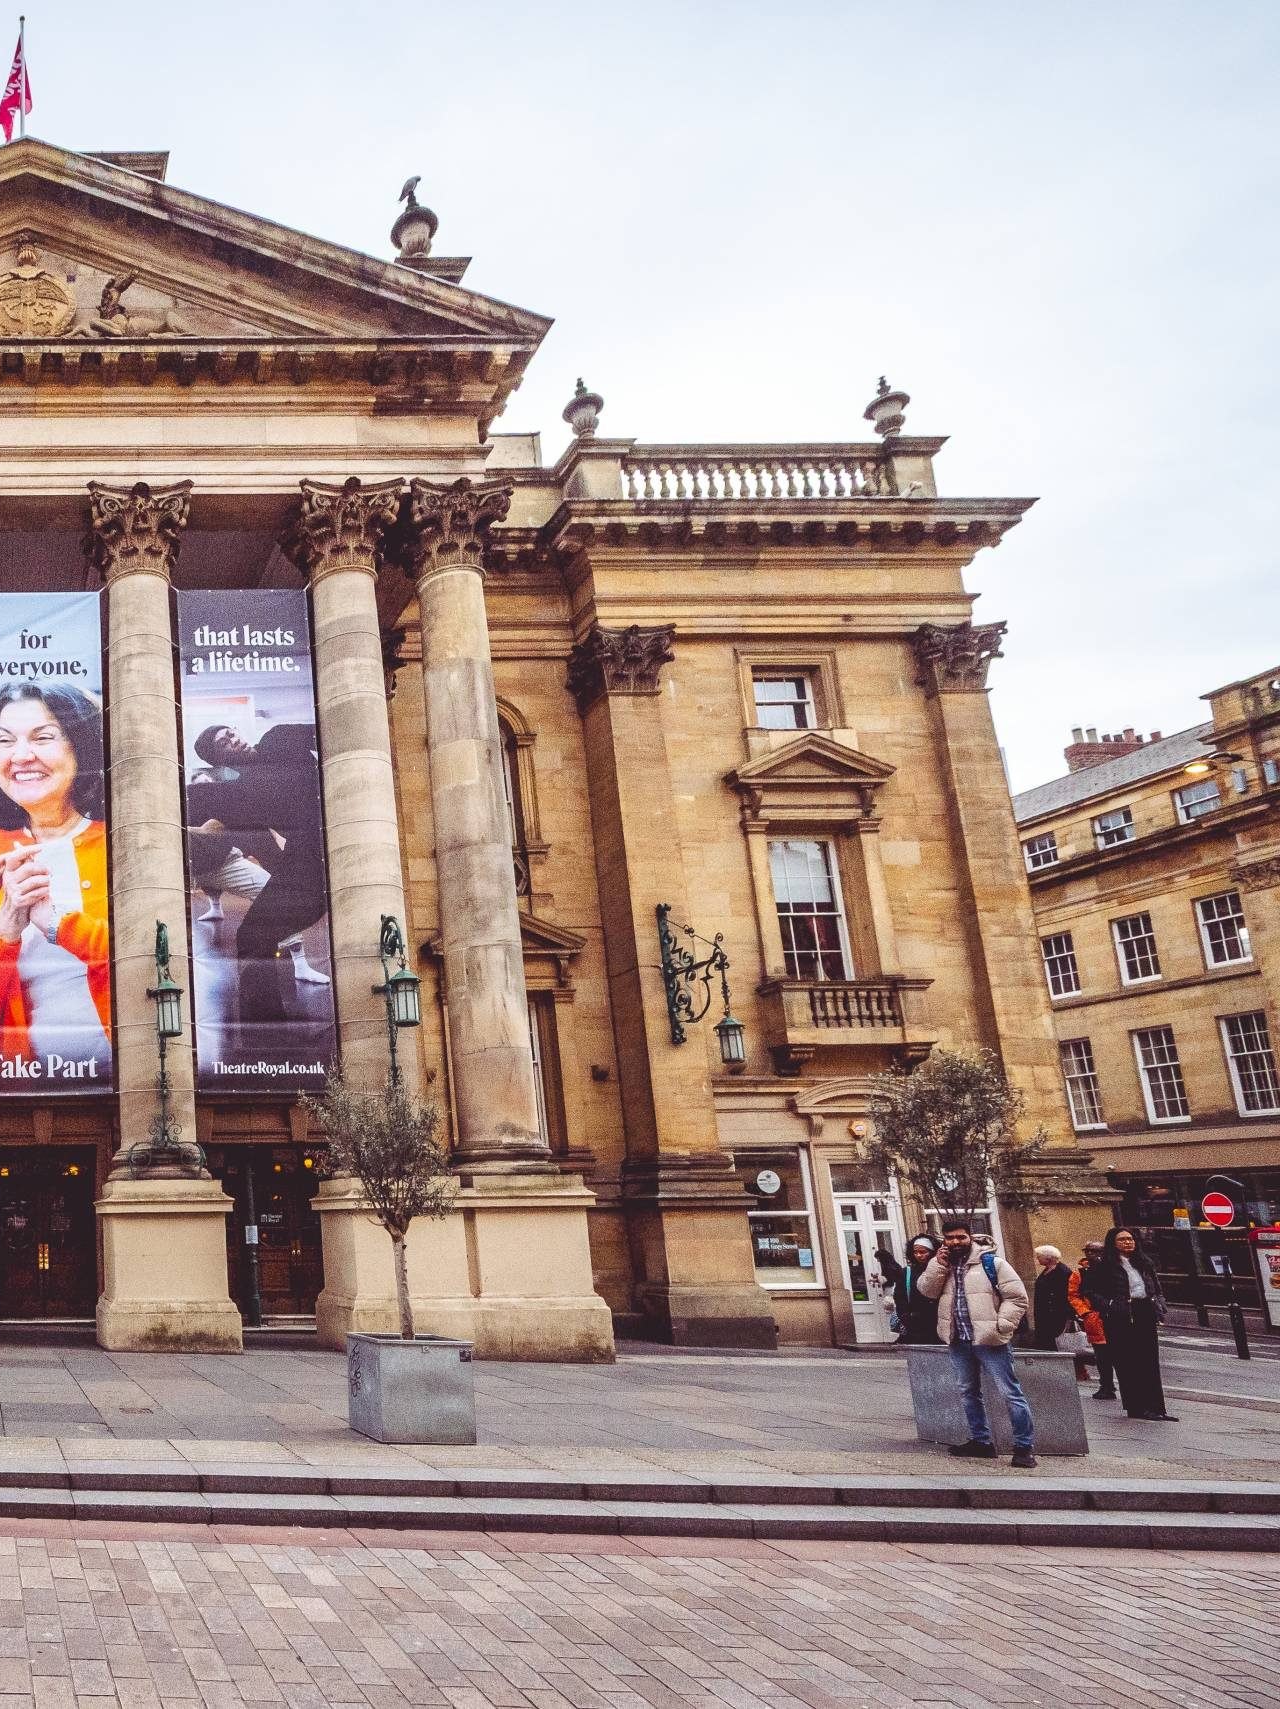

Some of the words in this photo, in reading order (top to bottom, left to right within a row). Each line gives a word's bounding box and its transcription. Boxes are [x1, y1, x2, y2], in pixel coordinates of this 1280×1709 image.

[19, 628, 52, 649] for
[193, 625, 240, 646] that
[243, 624, 295, 646] lasts
[191, 657, 205, 673] a
[208, 651, 300, 672] lifetime.
[47, 1053, 99, 1078] Part
[211, 1061, 325, 1077] TheatreRoyal.co.uk
